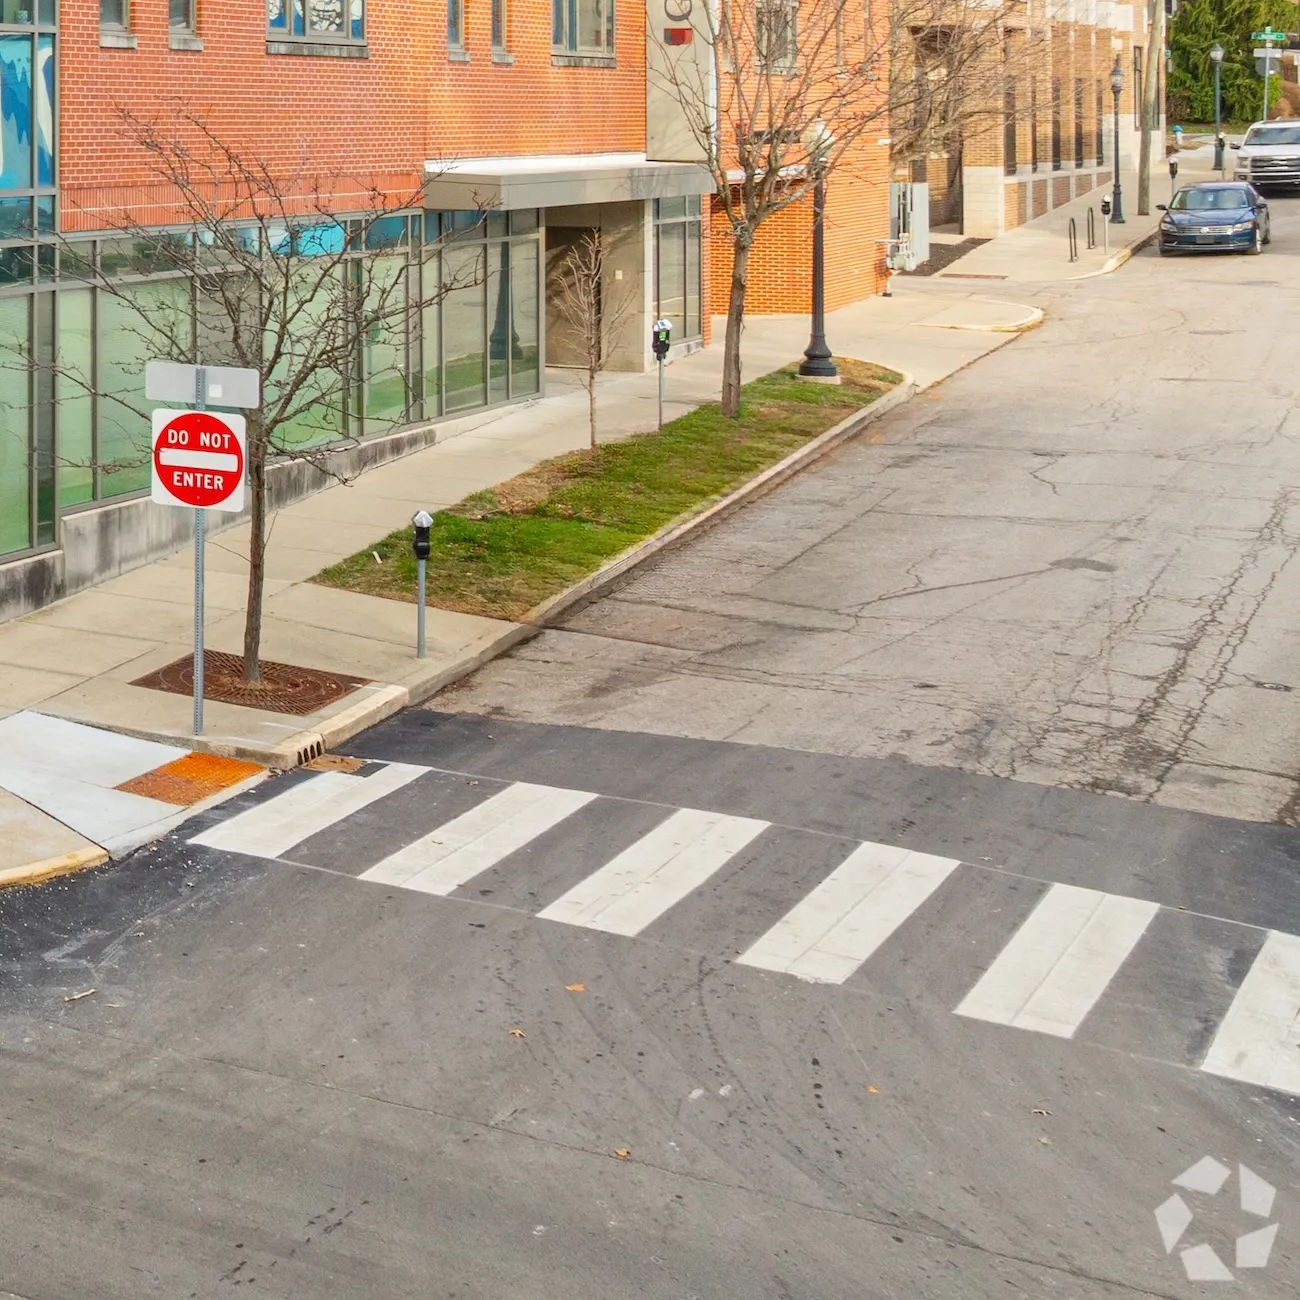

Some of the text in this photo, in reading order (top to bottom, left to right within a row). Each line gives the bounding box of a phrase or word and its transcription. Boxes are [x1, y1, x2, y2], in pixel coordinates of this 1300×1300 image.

[167, 429, 232, 450] DO NOT
[173, 471, 225, 491] ENTER
